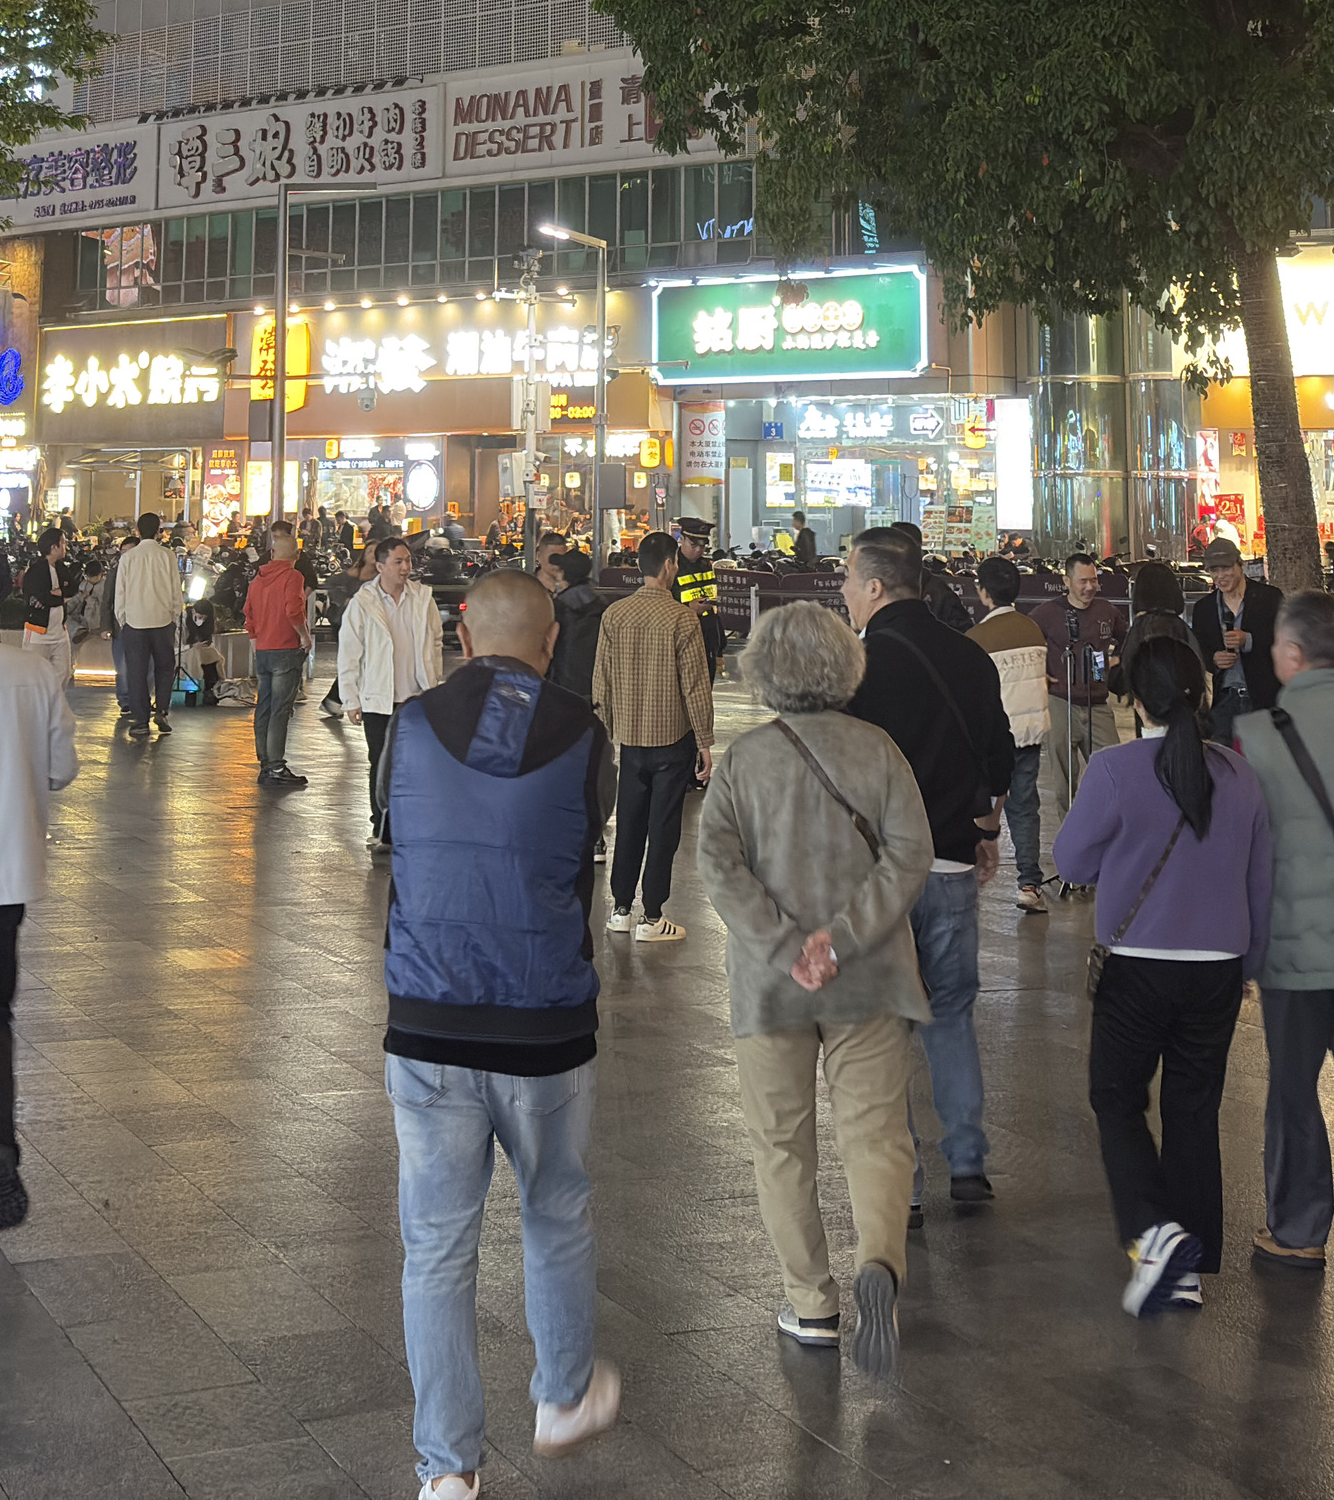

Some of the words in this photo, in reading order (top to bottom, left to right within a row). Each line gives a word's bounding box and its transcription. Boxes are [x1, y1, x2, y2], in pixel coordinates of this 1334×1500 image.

[453, 83, 574, 127] MONANA
[304, 139, 404, 179] 自助火锅
[453, 116, 579, 162] DESSERT
[770, 427, 776, 436] 3
[689, 450, 724, 458] 电动车禁止
